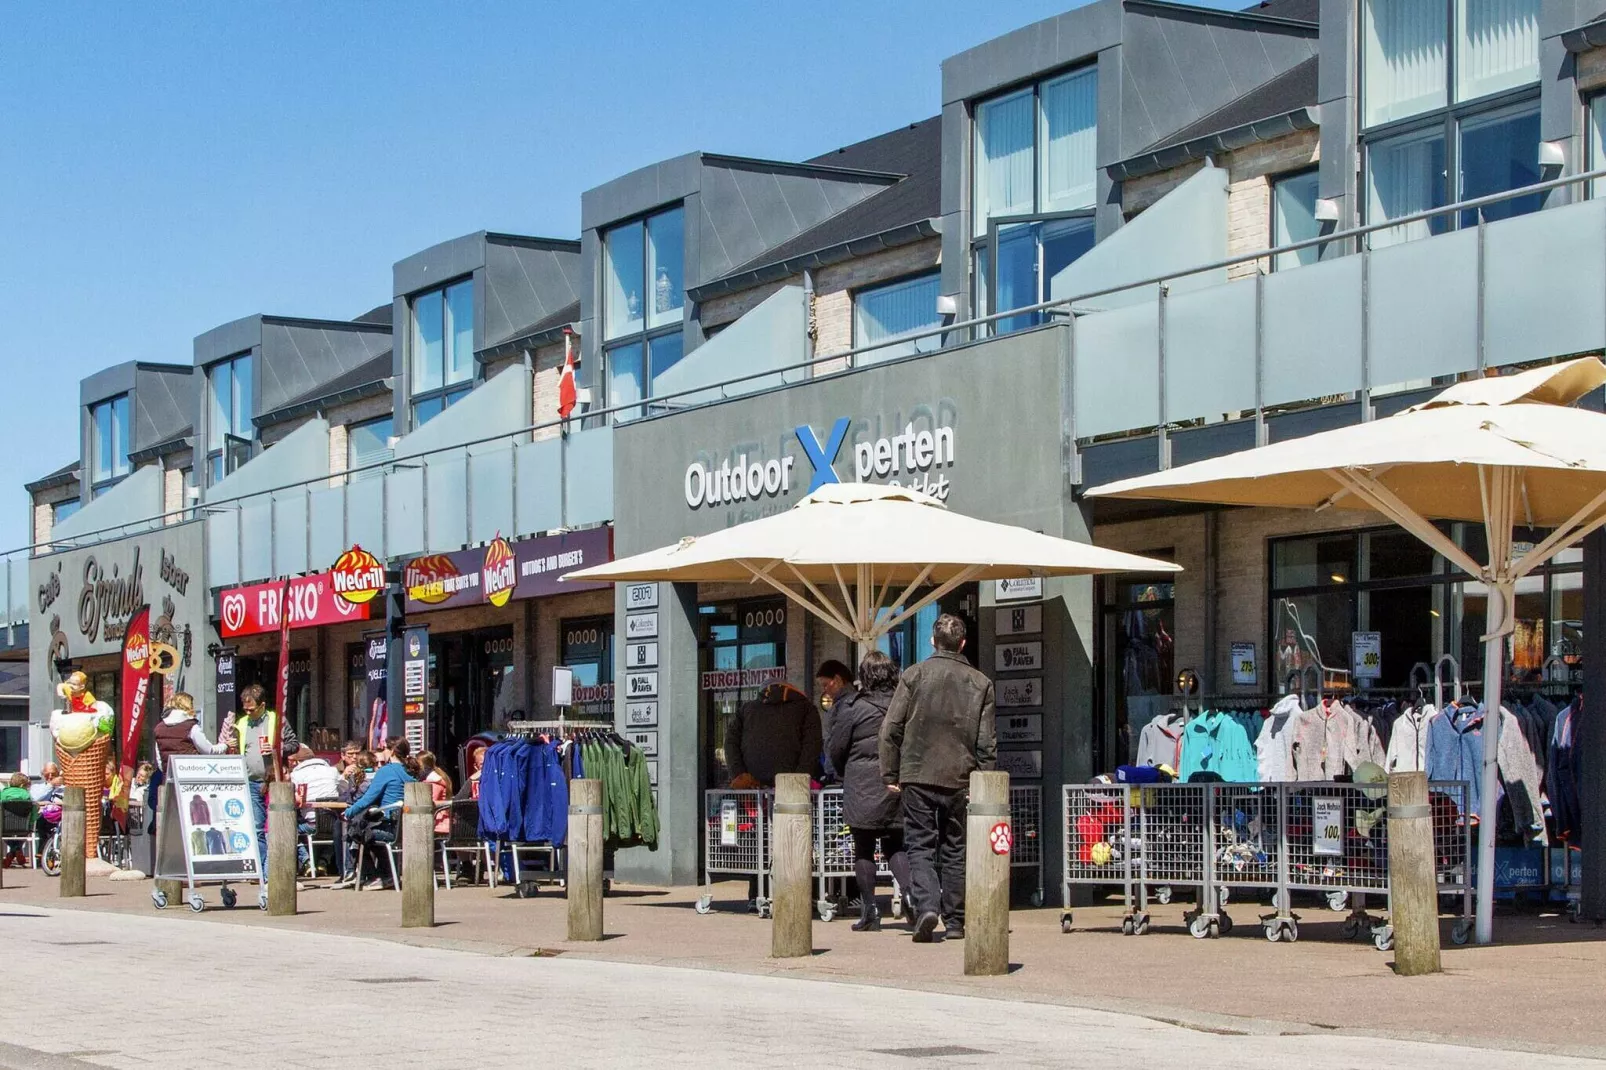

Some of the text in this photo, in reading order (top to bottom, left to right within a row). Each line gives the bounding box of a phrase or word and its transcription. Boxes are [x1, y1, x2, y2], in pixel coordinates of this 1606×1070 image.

[684, 453, 795, 509] Outdoor
[795, 416, 851, 494] X
[855, 421, 955, 483] perten
[546, 555, 558, 571] AND
[160, 547, 190, 597] Isbar
[332, 567, 384, 592] WeGrill
[469, 572, 479, 588] YOU
[483, 557, 515, 594] WeGrill
[702, 670, 748, 690] BURGER
[207, 763, 220, 774] X
[211, 784, 243, 792] JACKETS
[1317, 802, 1326, 810] Jack
[1509, 866, 1538, 879] perten
